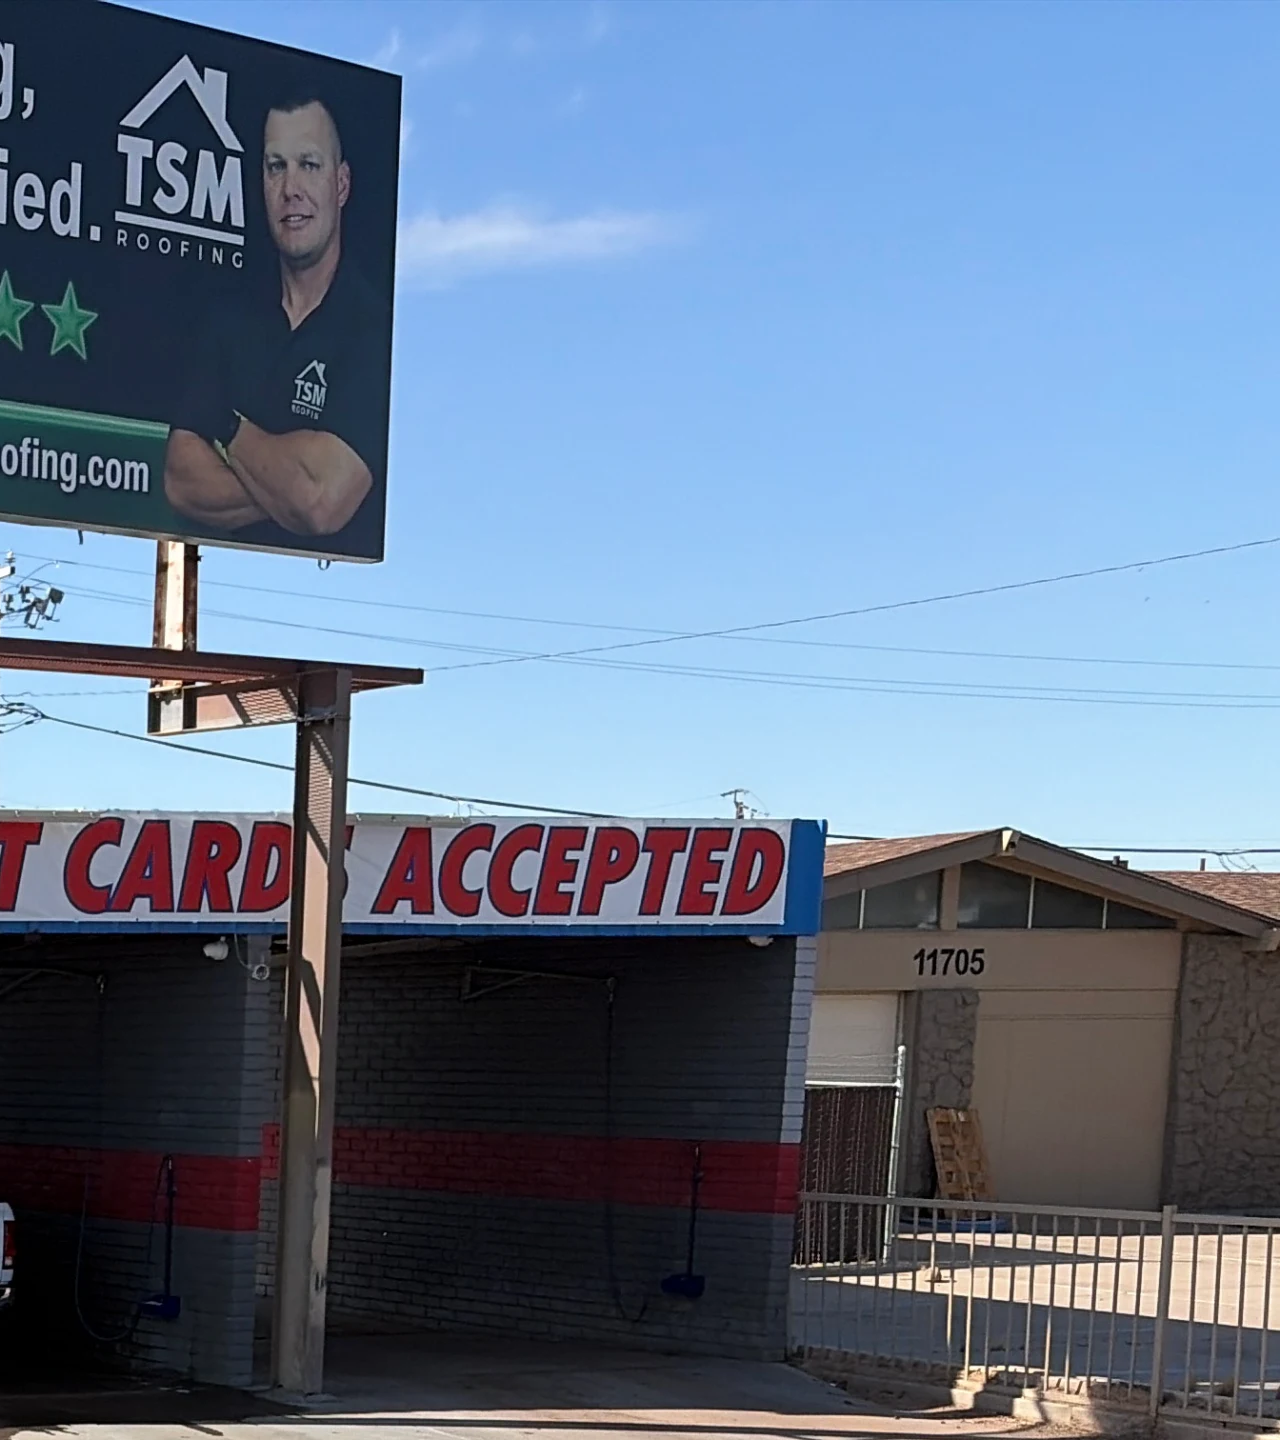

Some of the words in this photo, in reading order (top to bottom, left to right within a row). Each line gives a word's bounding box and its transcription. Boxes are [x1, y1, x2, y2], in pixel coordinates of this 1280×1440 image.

[117, 133, 245, 228] TSM
[116, 228, 243, 268] ROOFING
[294, 379, 327, 408] TSM
[63, 816, 355, 914] CARD
[370, 822, 787, 919] ACCEPTED
[913, 948, 985, 976] 11705
